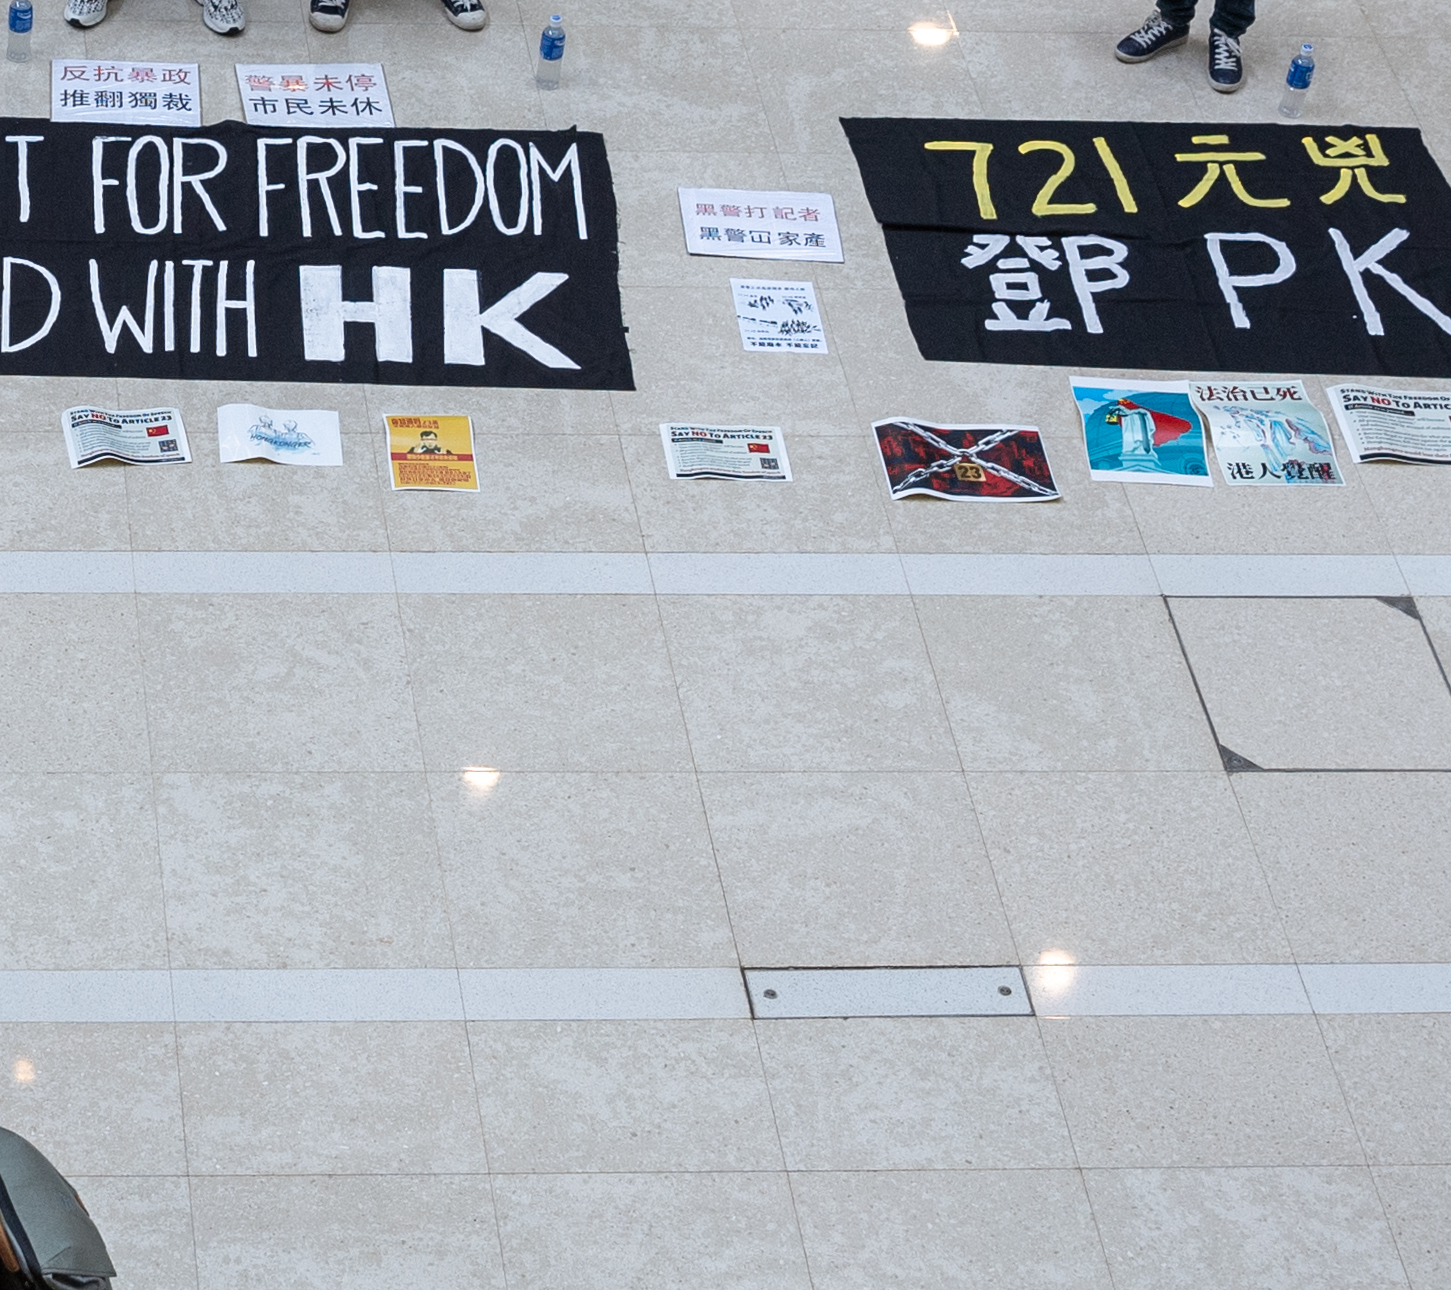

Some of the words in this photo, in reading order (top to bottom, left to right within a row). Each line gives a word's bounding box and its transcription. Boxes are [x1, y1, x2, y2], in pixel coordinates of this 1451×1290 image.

[60, 65, 192, 85] 反抗暴政
[245, 73, 378, 92] 警暴未停
[60, 90, 192, 112] 推翻獨裁
[249, 97, 383, 116] 市民未休
[91, 133, 228, 236] FOR
[256, 134, 589, 241] FREEDOM
[695, 203, 820, 222] 黑警打記者
[88, 258, 258, 358] WITH
[298, 264, 582, 371] HK
[1195, 385, 1303, 403] 法治已死
[1371, 397, 1391, 406] NO
[957, 464, 982, 480] 23
[1227, 461, 1337, 481] 港人覺醒
